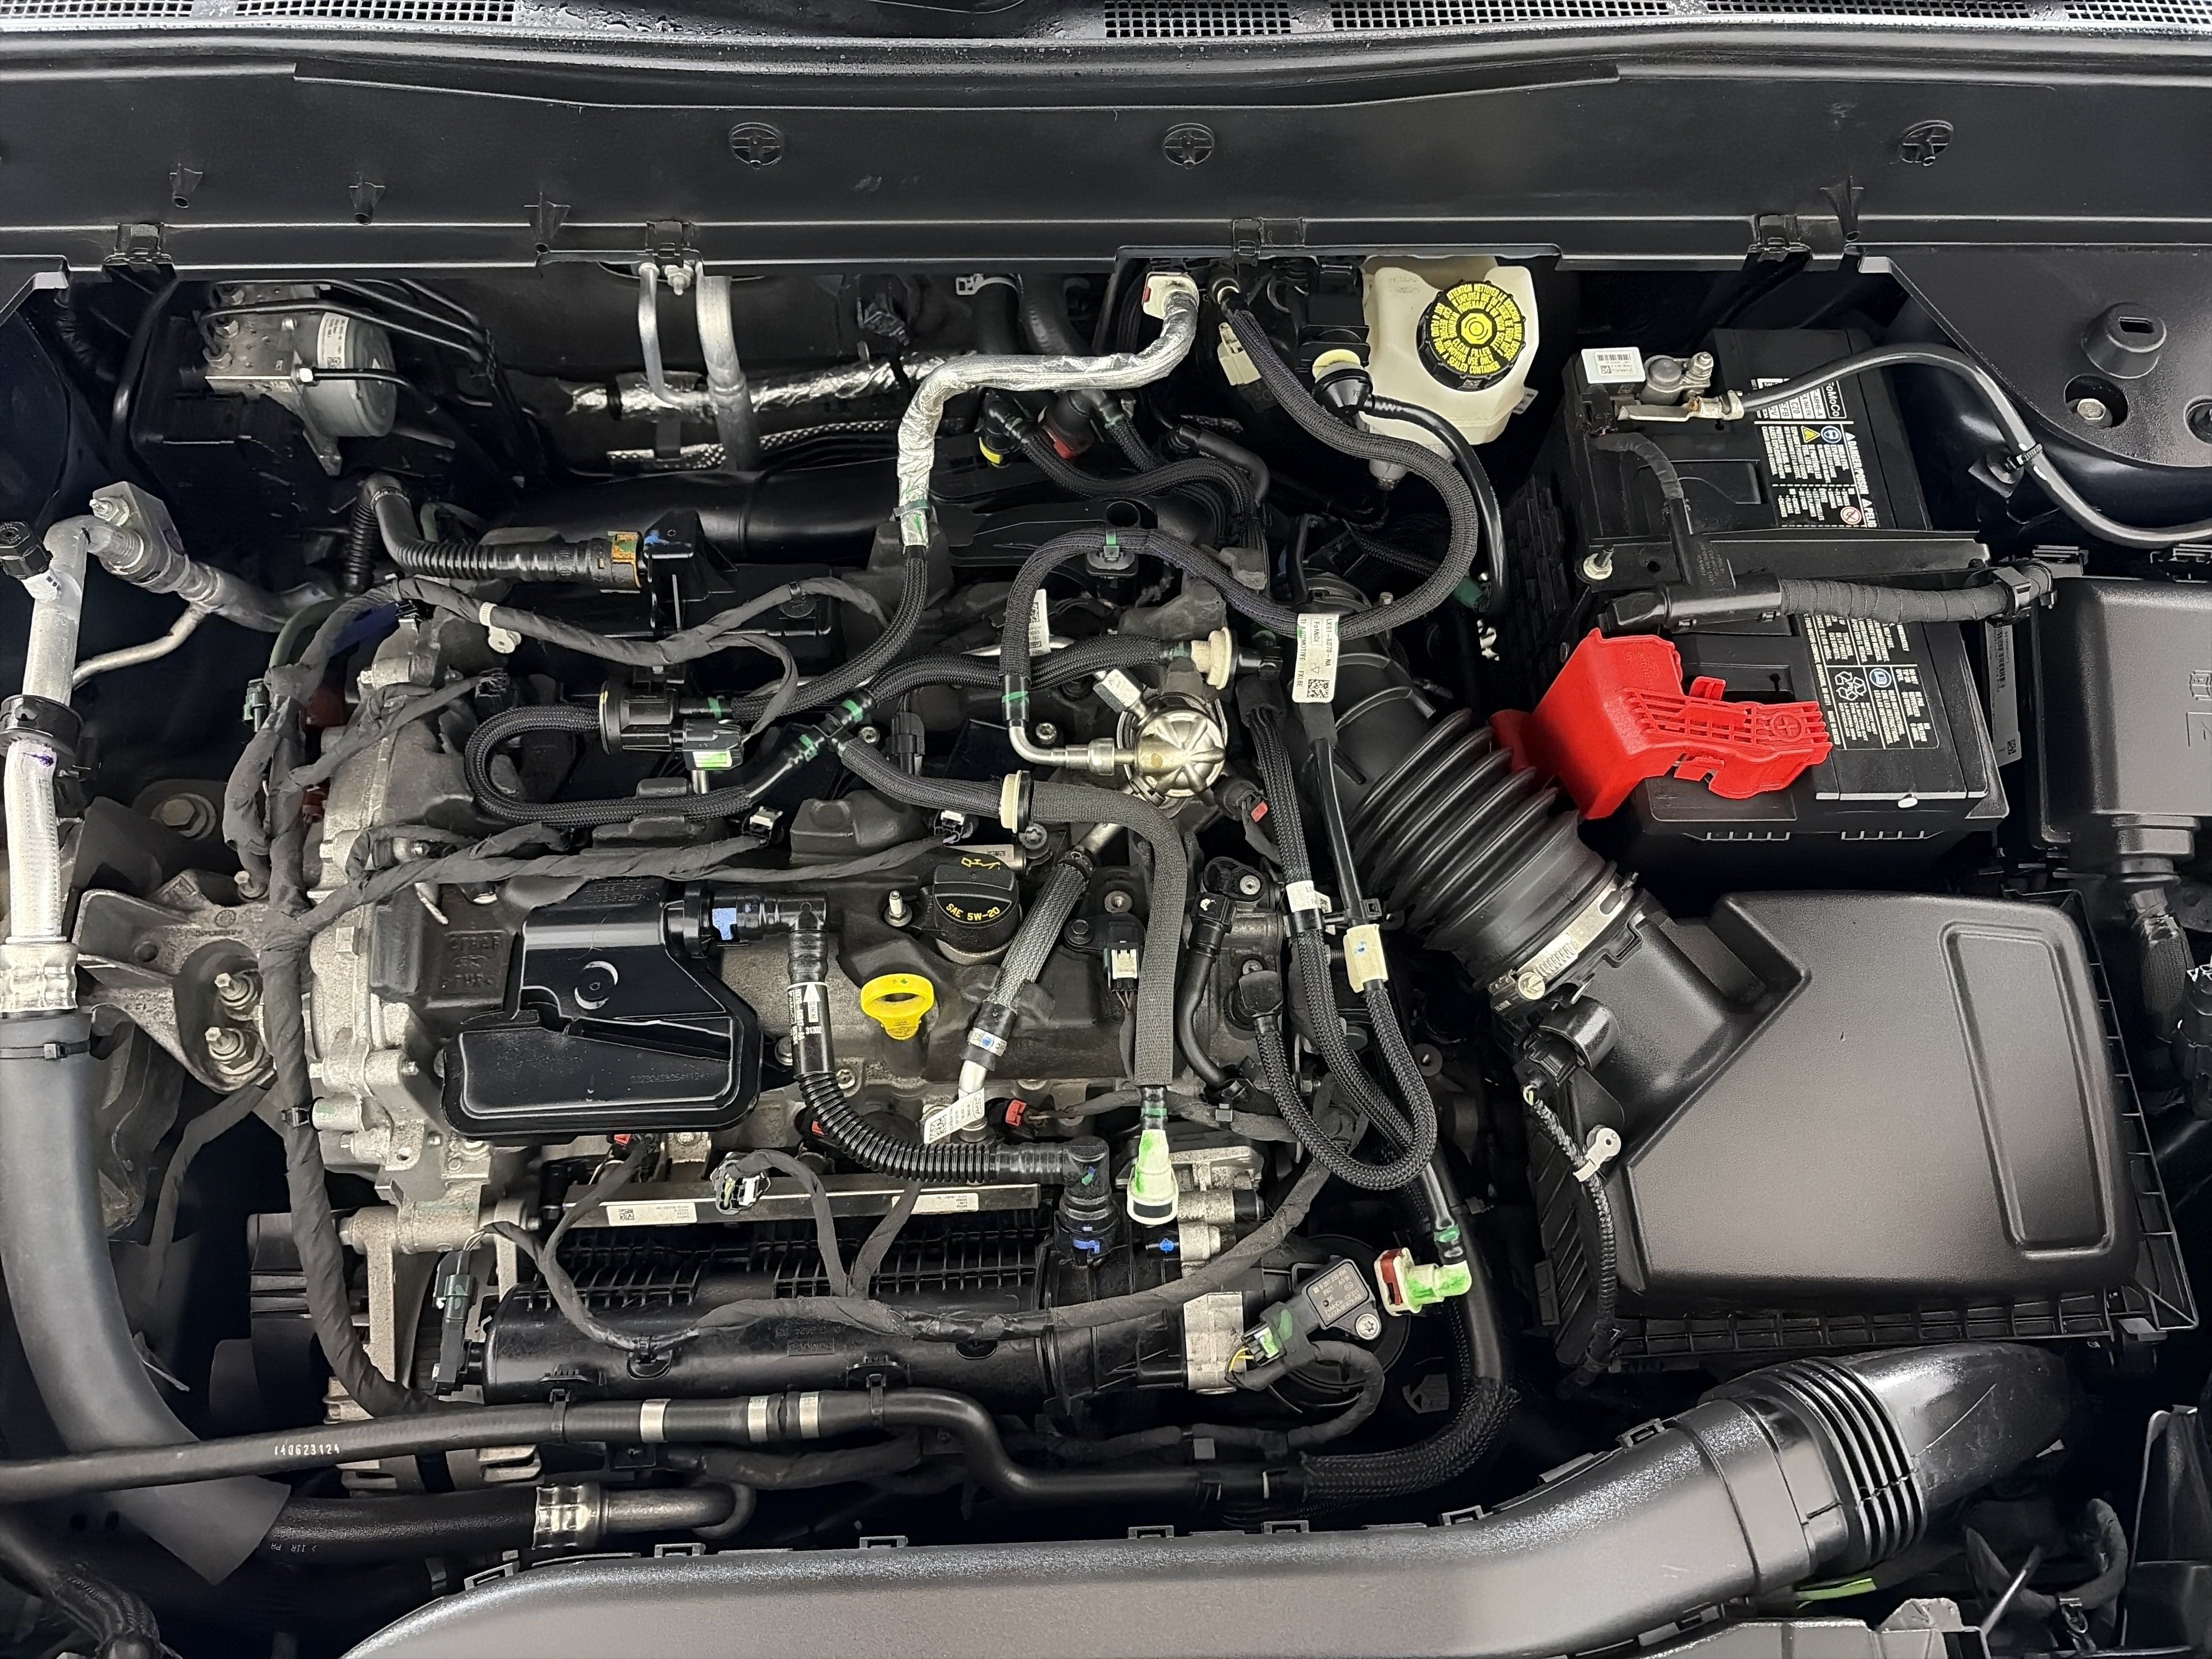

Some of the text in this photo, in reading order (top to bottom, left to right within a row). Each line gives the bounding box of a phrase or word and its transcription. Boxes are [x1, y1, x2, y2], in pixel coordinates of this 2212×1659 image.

[1481, 292, 1491, 302] QUE
[1490, 297, 1498, 305] DU
[1434, 302, 1444, 315] DOT
[1446, 284, 1472, 301] ATTENTION
[1474, 284, 1499, 297] NETTOYER
[1498, 292, 1506, 302] LE
[1504, 298, 1521, 322] BOUCHON
[1514, 323, 1522, 341] AVANT
[1457, 301, 1487, 314] PROVENANT
[1431, 320, 1440, 337] FLUID
[1440, 307, 1494, 365] CAP BEFORE REMOVING USE ONLY
[1448, 312, 1491, 357] WARNING CLEAN FILLER
[1505, 328, 1514, 342] FREIN
[1433, 338, 1446, 354] FROM
[1501, 341, 1510, 353] DOT
[1447, 357, 1468, 373] SEALED
[1469, 361, 1500, 374] CONTAINER
[1780, 403, 1789, 416] EFB
[1791, 402, 1800, 414] C20
[1847, 441, 1877, 527] DANGER/POISON PELIG
[1803, 617, 1812, 628] FORD
[1807, 629, 1816, 643] MOTOR
[1846, 682, 1854, 691] Pb
[1910, 675, 1918, 684] NOT
[1908, 691, 1920, 716] RENVERSER
[1916, 698, 1925, 706] PAS
[1826, 710, 1836, 723] MADE
[1865, 702, 1874, 721] BATTERY
[1873, 690, 1893, 744] LEA LAS INSTRUCCIONES.
[1880, 690, 1889, 699] LIRE
[1885, 709, 1900, 742] INSTRUCTIONS.
[1888, 690, 1905, 736] READ INSTRUCTIONS.
[1840, 712, 1850, 737] RECICLADA
[1861, 709, 1871, 732] RECYCLED
[1831, 728, 1841, 744] MEXICO
[1916, 723, 1927, 741] VOLTEAR
[946, 903, 1000, 921] SAE 5W-20
[1323, 1299, 1344, 1314] FoMoCo
[274, 1443, 340, 1456] 140623124
